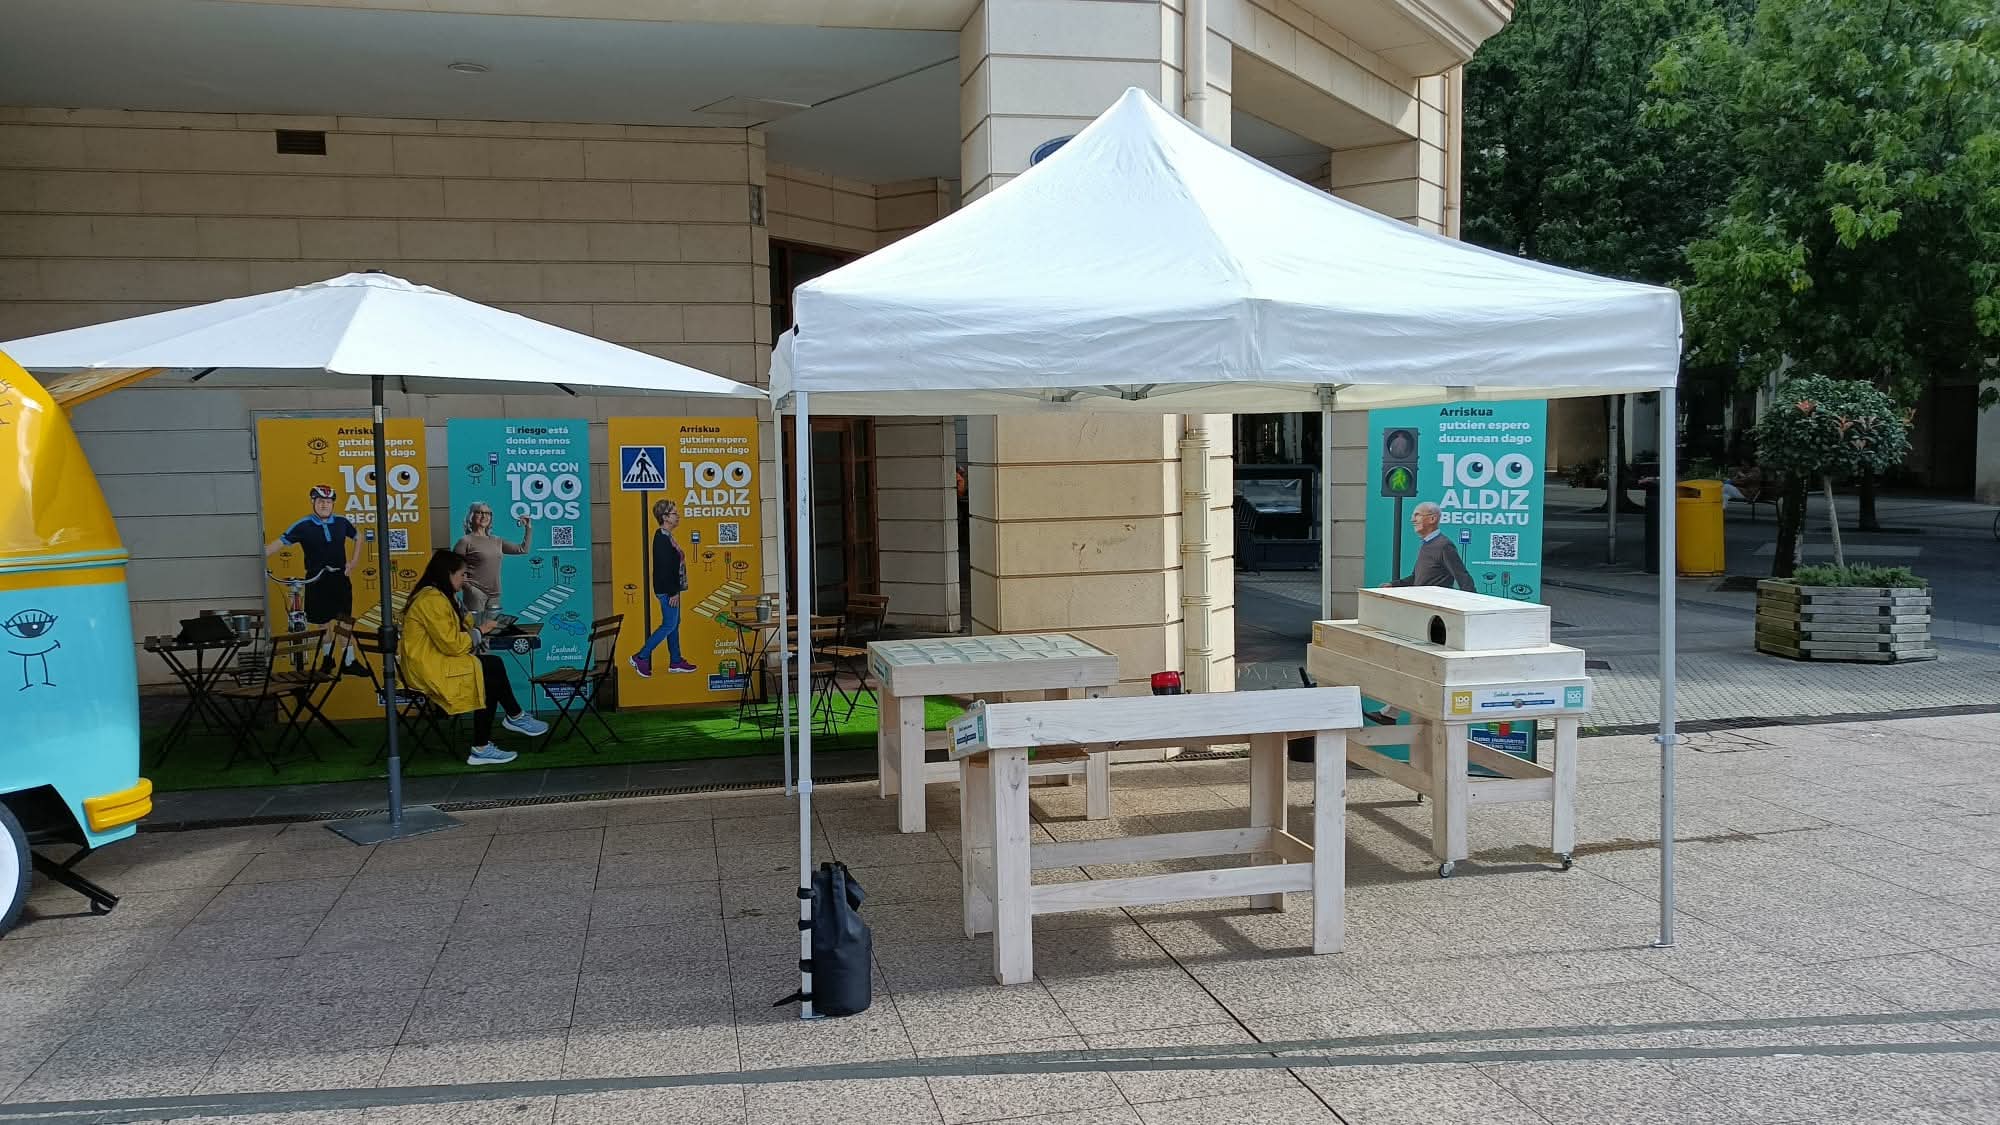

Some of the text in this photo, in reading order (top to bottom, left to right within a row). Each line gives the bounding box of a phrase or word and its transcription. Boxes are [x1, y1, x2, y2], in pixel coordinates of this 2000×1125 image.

[1440, 407, 1493, 416] Arriskua
[337, 427, 375, 435] Arrisk
[506, 426, 569, 436] El riesgo está
[1440, 420, 1530, 431] gutxien espero
[385, 439, 414, 448] spero
[680, 435, 747, 445] gutxien espero
[1439, 434, 1532, 445] duzunean dago
[391, 448, 416, 458] dago
[529, 448, 566, 456] esperas
[680, 446, 749, 455] duzunean dago
[506, 462, 579, 472] ANDA CON
[1437, 453, 1534, 488] 100
[338, 464, 420, 493] 100
[680, 461, 752, 488] 100
[506, 474, 582, 500] 100
[683, 489, 750, 506] ALDIZ
[1440, 489, 1529, 510] ALDIZ
[510, 502, 580, 520] OJOS
[684, 506, 750, 517] BEGIRATU
[345, 512, 420, 524] BEGATU
[1440, 512, 1529, 526] BEGIRATU
